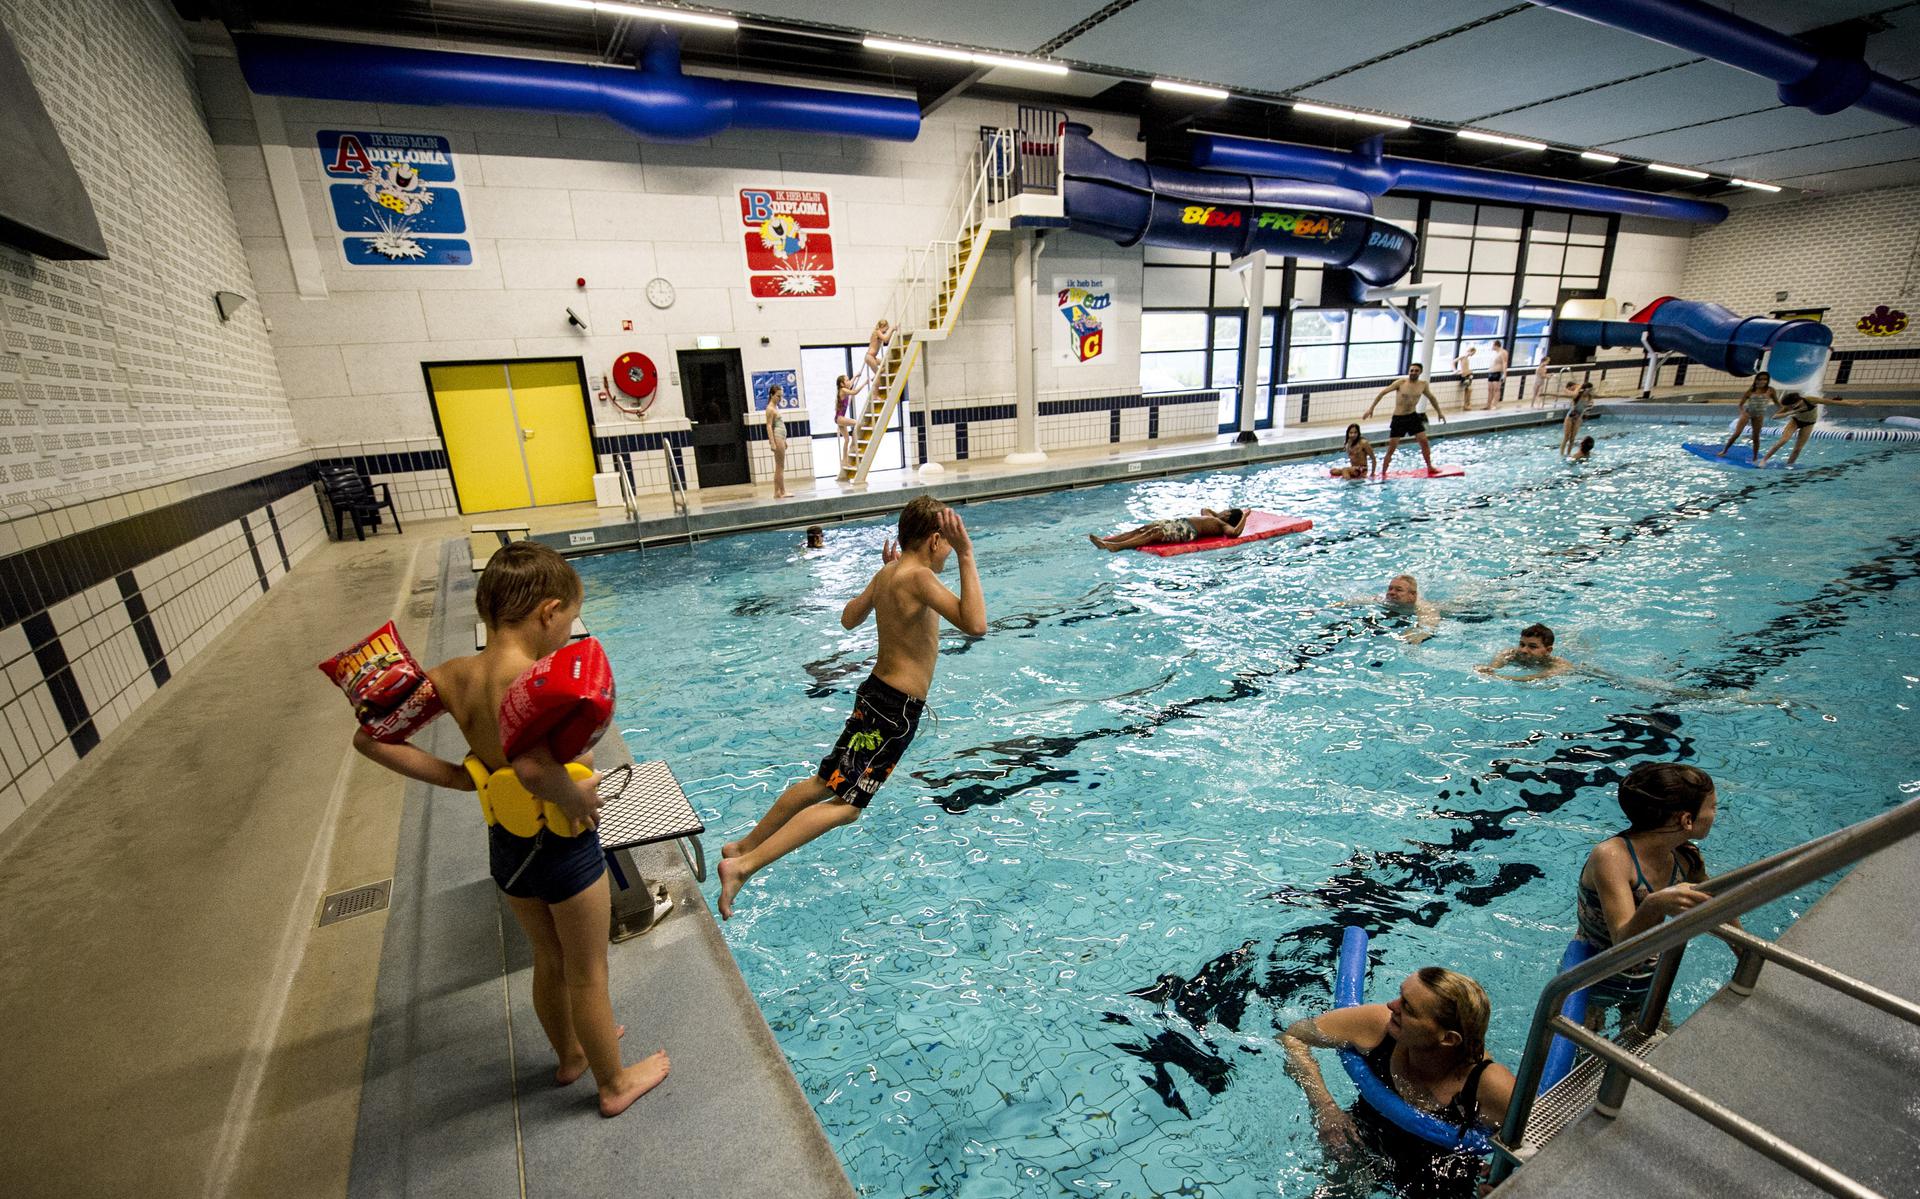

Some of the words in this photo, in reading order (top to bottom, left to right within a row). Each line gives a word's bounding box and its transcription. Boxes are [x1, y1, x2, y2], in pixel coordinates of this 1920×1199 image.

[370, 134, 385, 146] IK
[386, 135, 409, 147] HEB
[327, 134, 382, 173] A
[367, 147, 448, 165] DIPLOMA
[776, 191, 785, 200] IK
[743, 191, 773, 222] B
[772, 201, 826, 215] DIPLOMA
[1368, 231, 1404, 250] BAAN
[1076, 280, 1090, 288] heb
[1084, 334, 1099, 358] C
